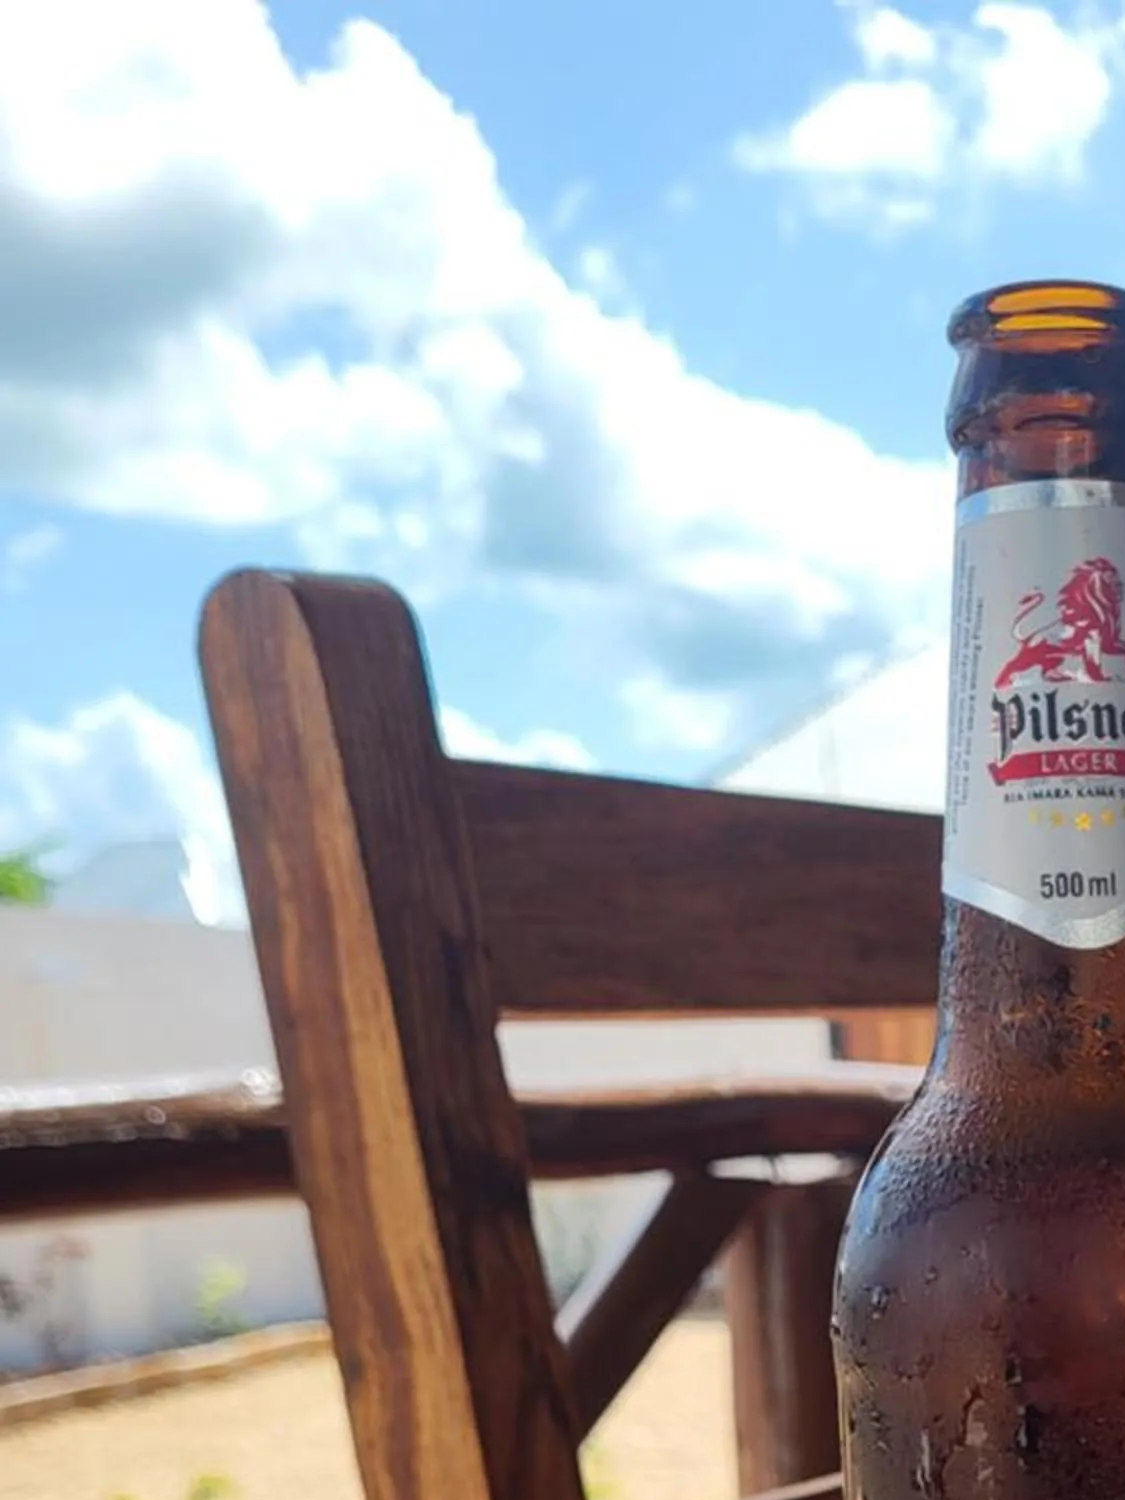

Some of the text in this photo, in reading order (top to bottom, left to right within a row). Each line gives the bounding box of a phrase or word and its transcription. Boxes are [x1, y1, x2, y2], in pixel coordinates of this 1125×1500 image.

[1040, 752, 1118, 773] LAGER
[1040, 871, 1117, 899] 500 ml
